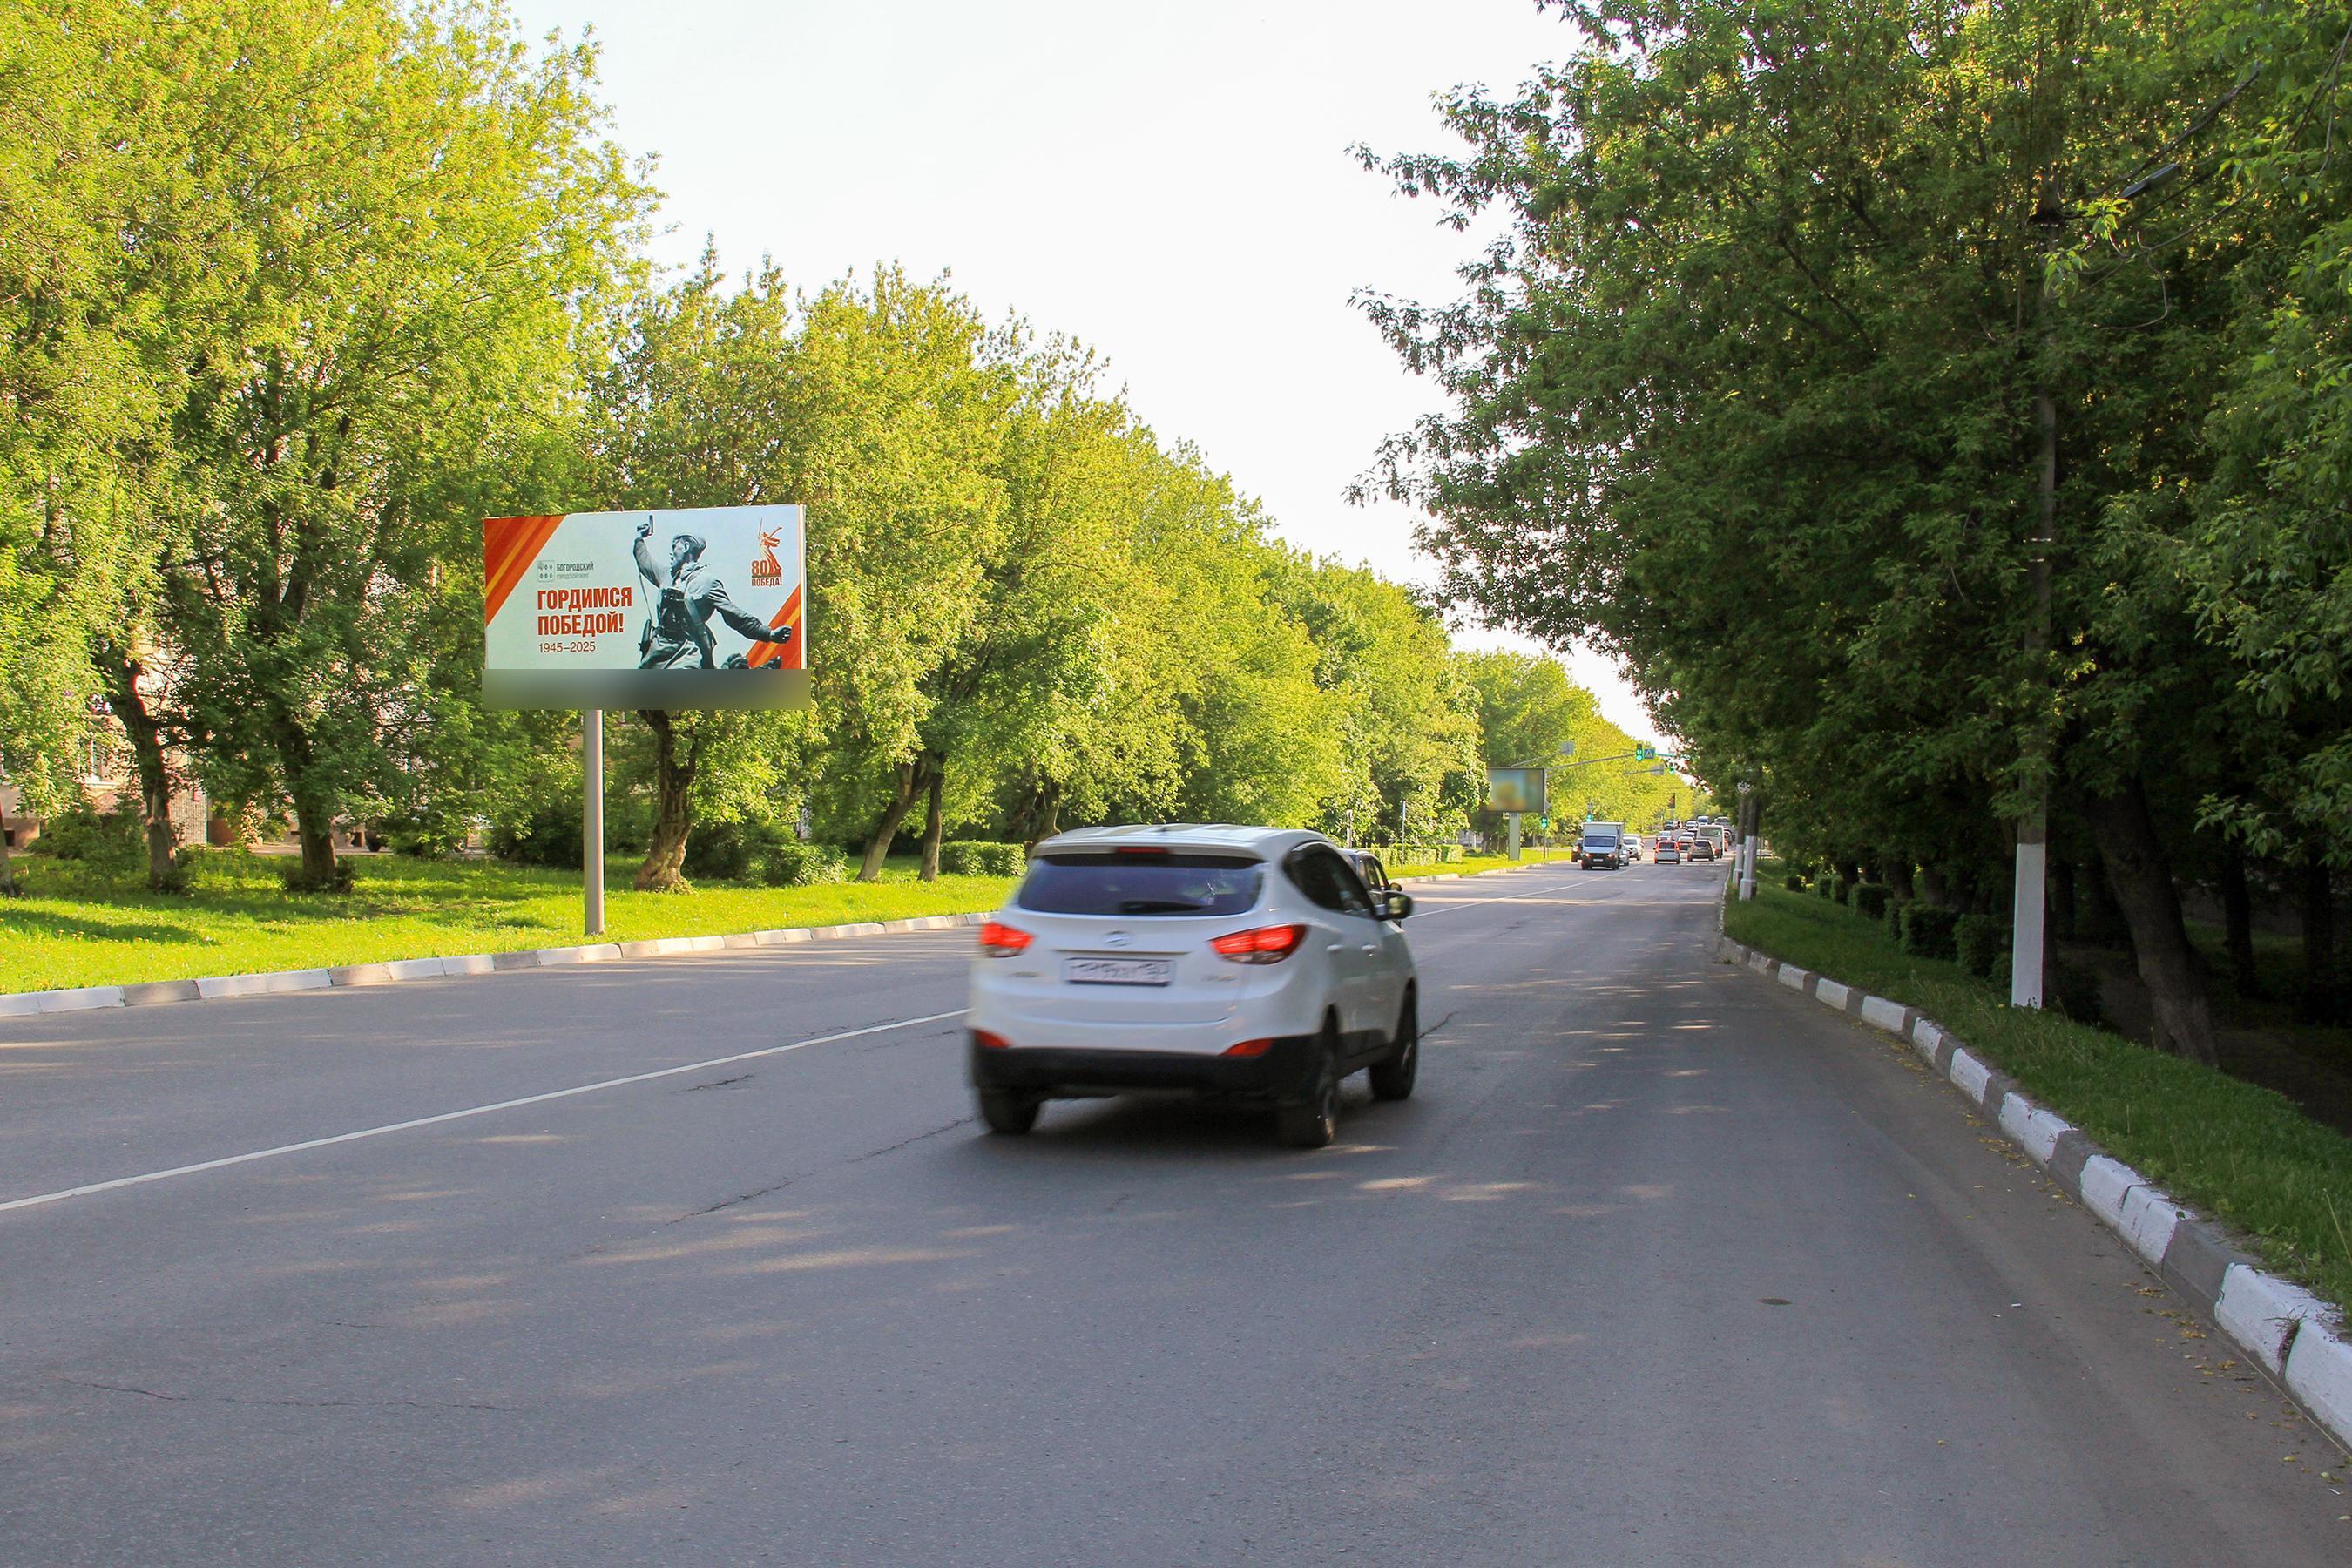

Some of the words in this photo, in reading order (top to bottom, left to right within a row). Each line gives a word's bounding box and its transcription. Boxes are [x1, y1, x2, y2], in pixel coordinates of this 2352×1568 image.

[557, 562, 594, 571] БОГОРОДСКИЙ
[752, 560, 767, 575] 80
[752, 578, 782, 587] ПОБЕДА!
[537, 586, 632, 612] ГОРДИМСЯ
[537, 611, 624, 637] ПОБЕДОЙ!
